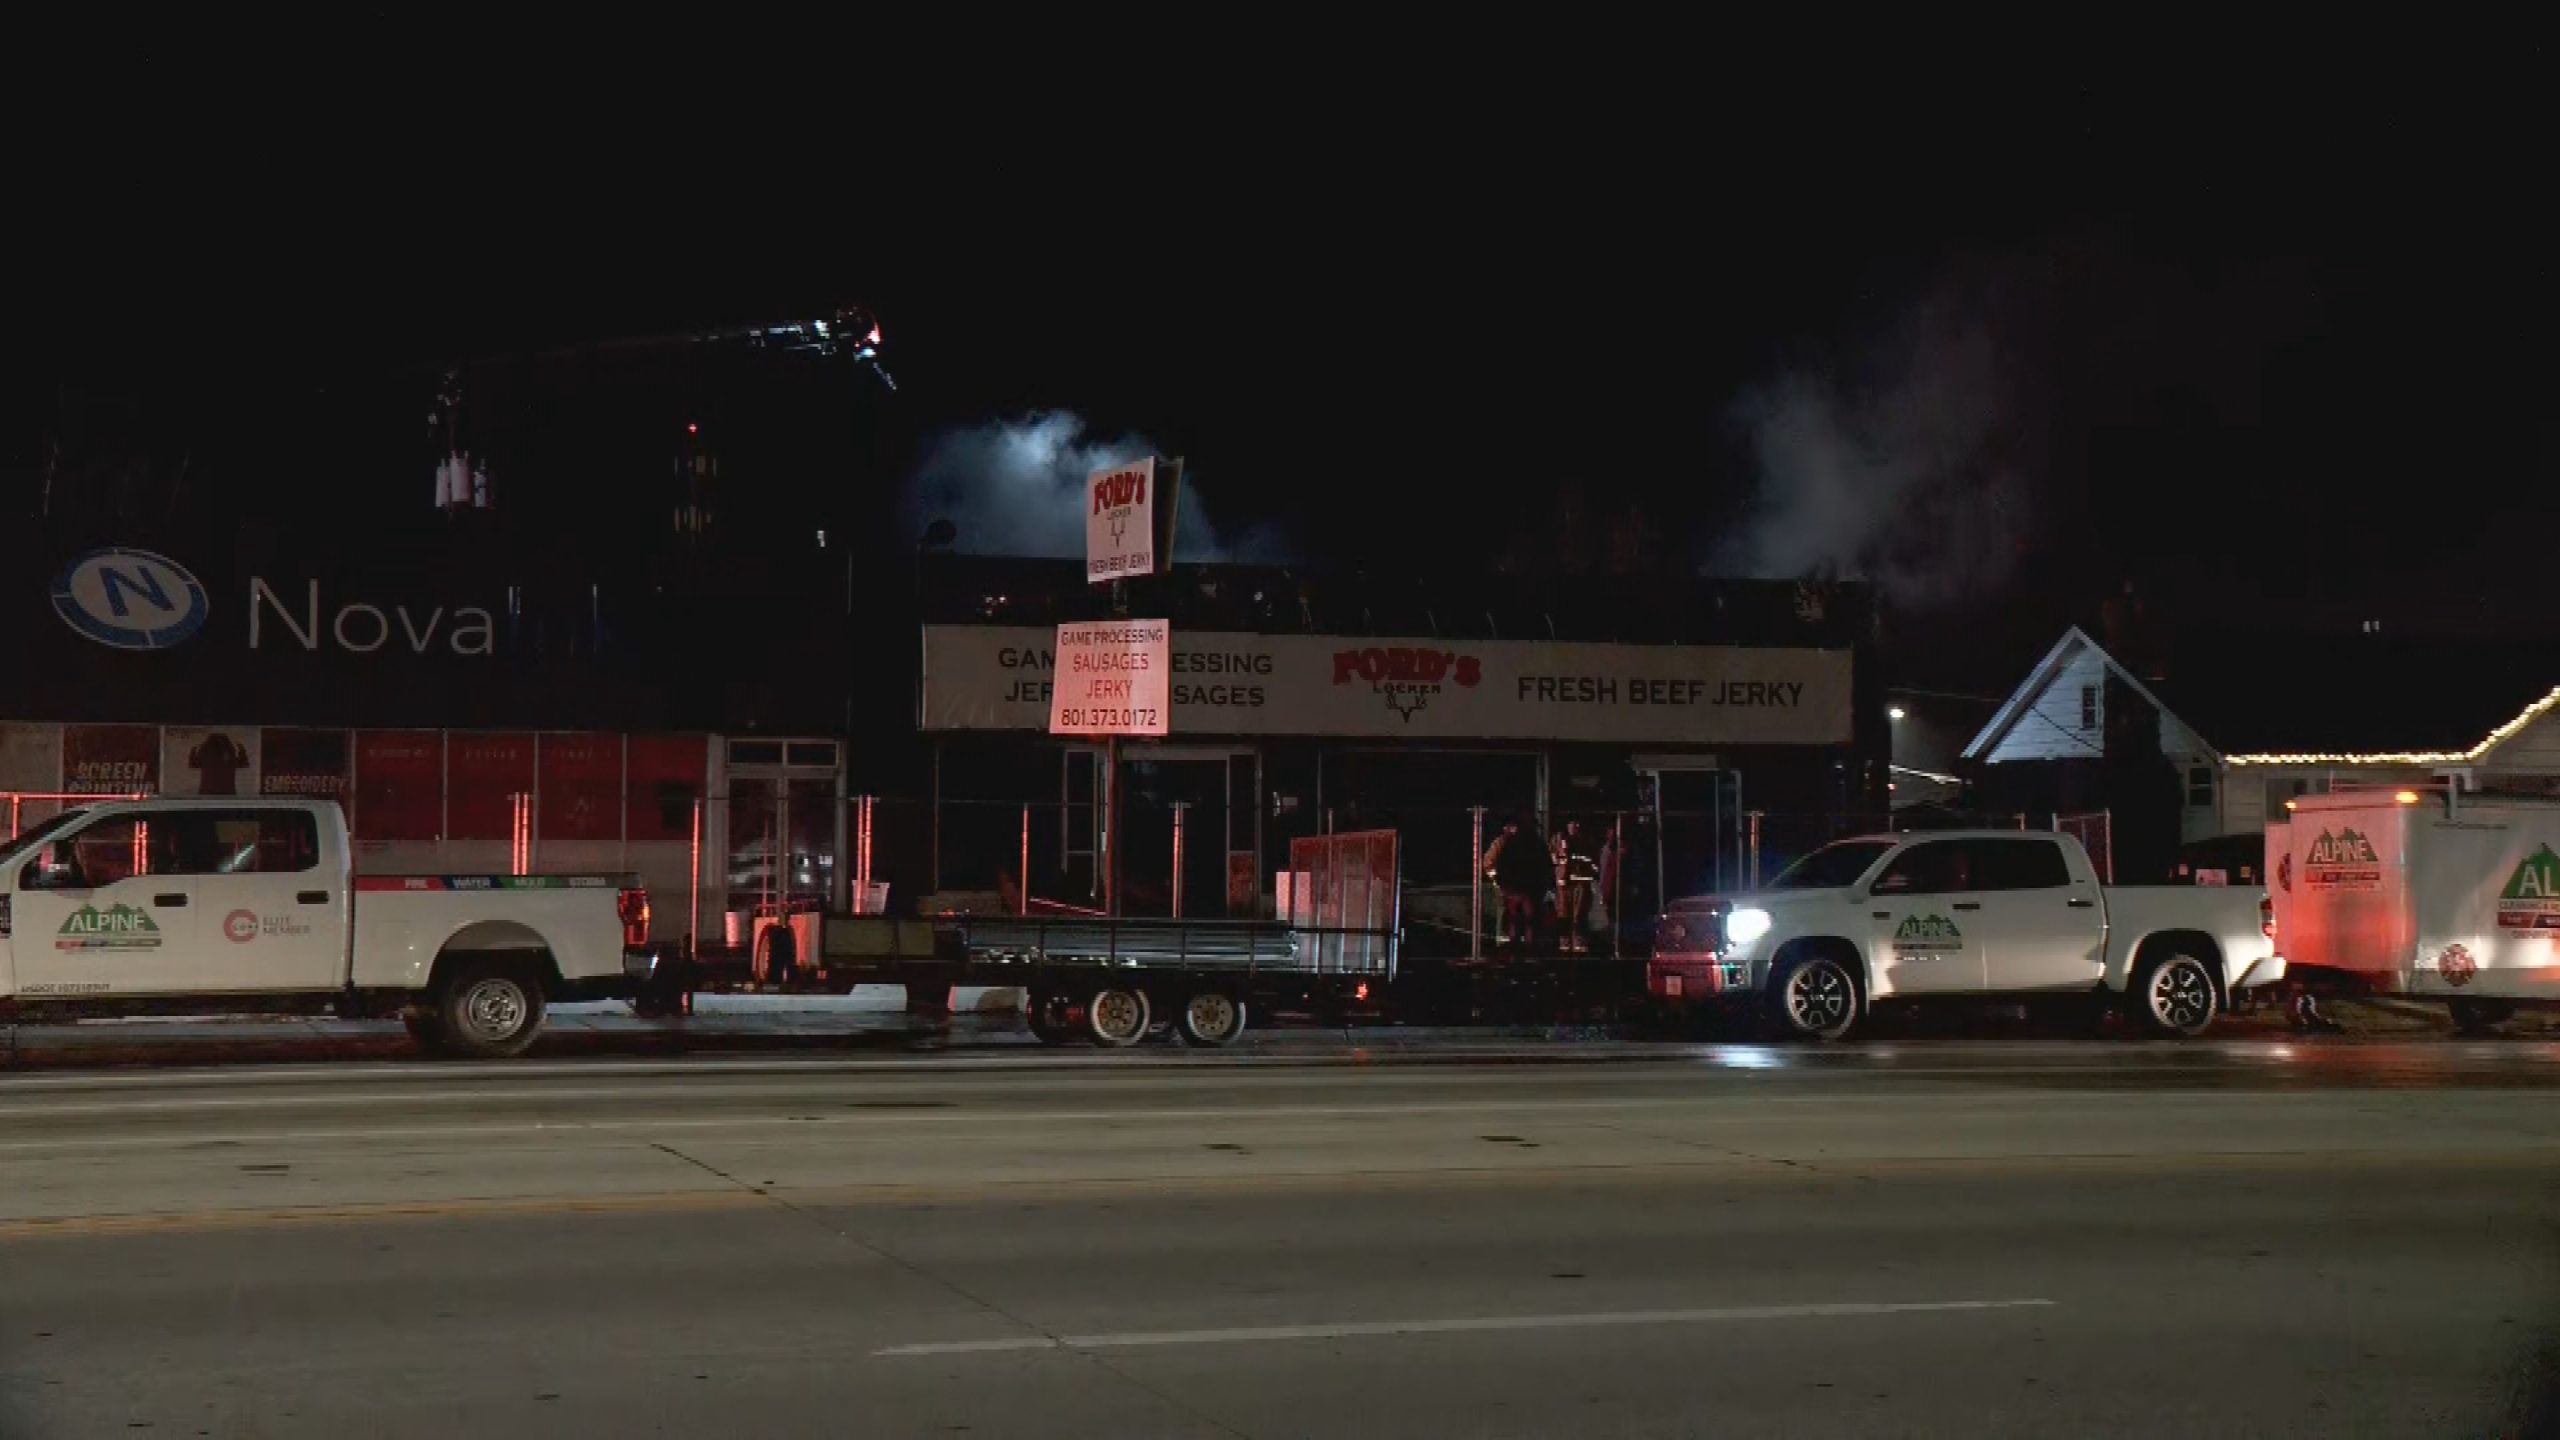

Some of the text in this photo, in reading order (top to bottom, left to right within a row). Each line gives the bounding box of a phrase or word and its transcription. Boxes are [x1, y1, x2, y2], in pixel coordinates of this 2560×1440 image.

[1061, 628, 1164, 646] GAME PROCESSING
[998, 647, 1273, 674] GAM ESSING
[1073, 653, 1150, 673] SAUSAGES
[1332, 647, 1482, 688] FORD'S
[1004, 680, 1265, 707] JER SAGES
[1086, 680, 1133, 699] JERKY
[1517, 677, 1804, 708] FRESH BEEF JERKY
[1061, 708, 1157, 727] 801.373.0172
[76, 761, 147, 780] SCREEN
[2313, 839, 2368, 862] ALPINE
[69, 913, 145, 932] ALPINE
[1900, 922, 1952, 938] ALPINE
